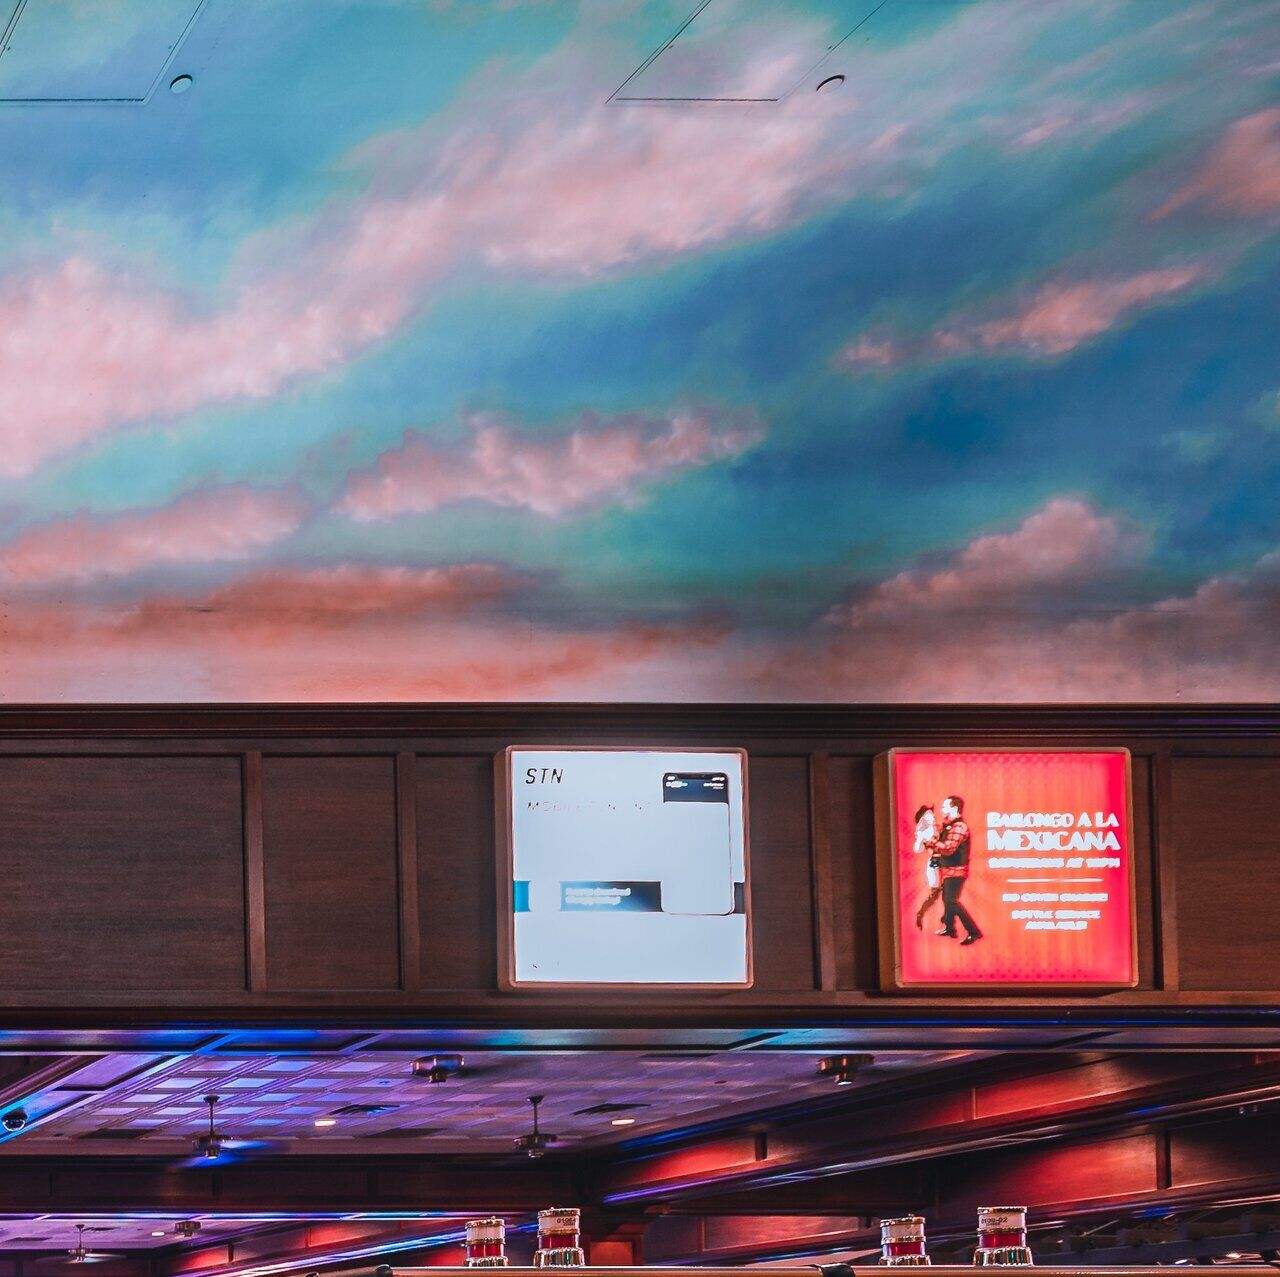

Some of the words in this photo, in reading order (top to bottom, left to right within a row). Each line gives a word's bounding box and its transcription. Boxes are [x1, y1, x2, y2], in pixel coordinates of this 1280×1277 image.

[525, 768, 564, 784] STN
[1077, 812, 1092, 827] A
[1095, 812, 1119, 827] LA
[987, 830, 1121, 851] MEXICANA
